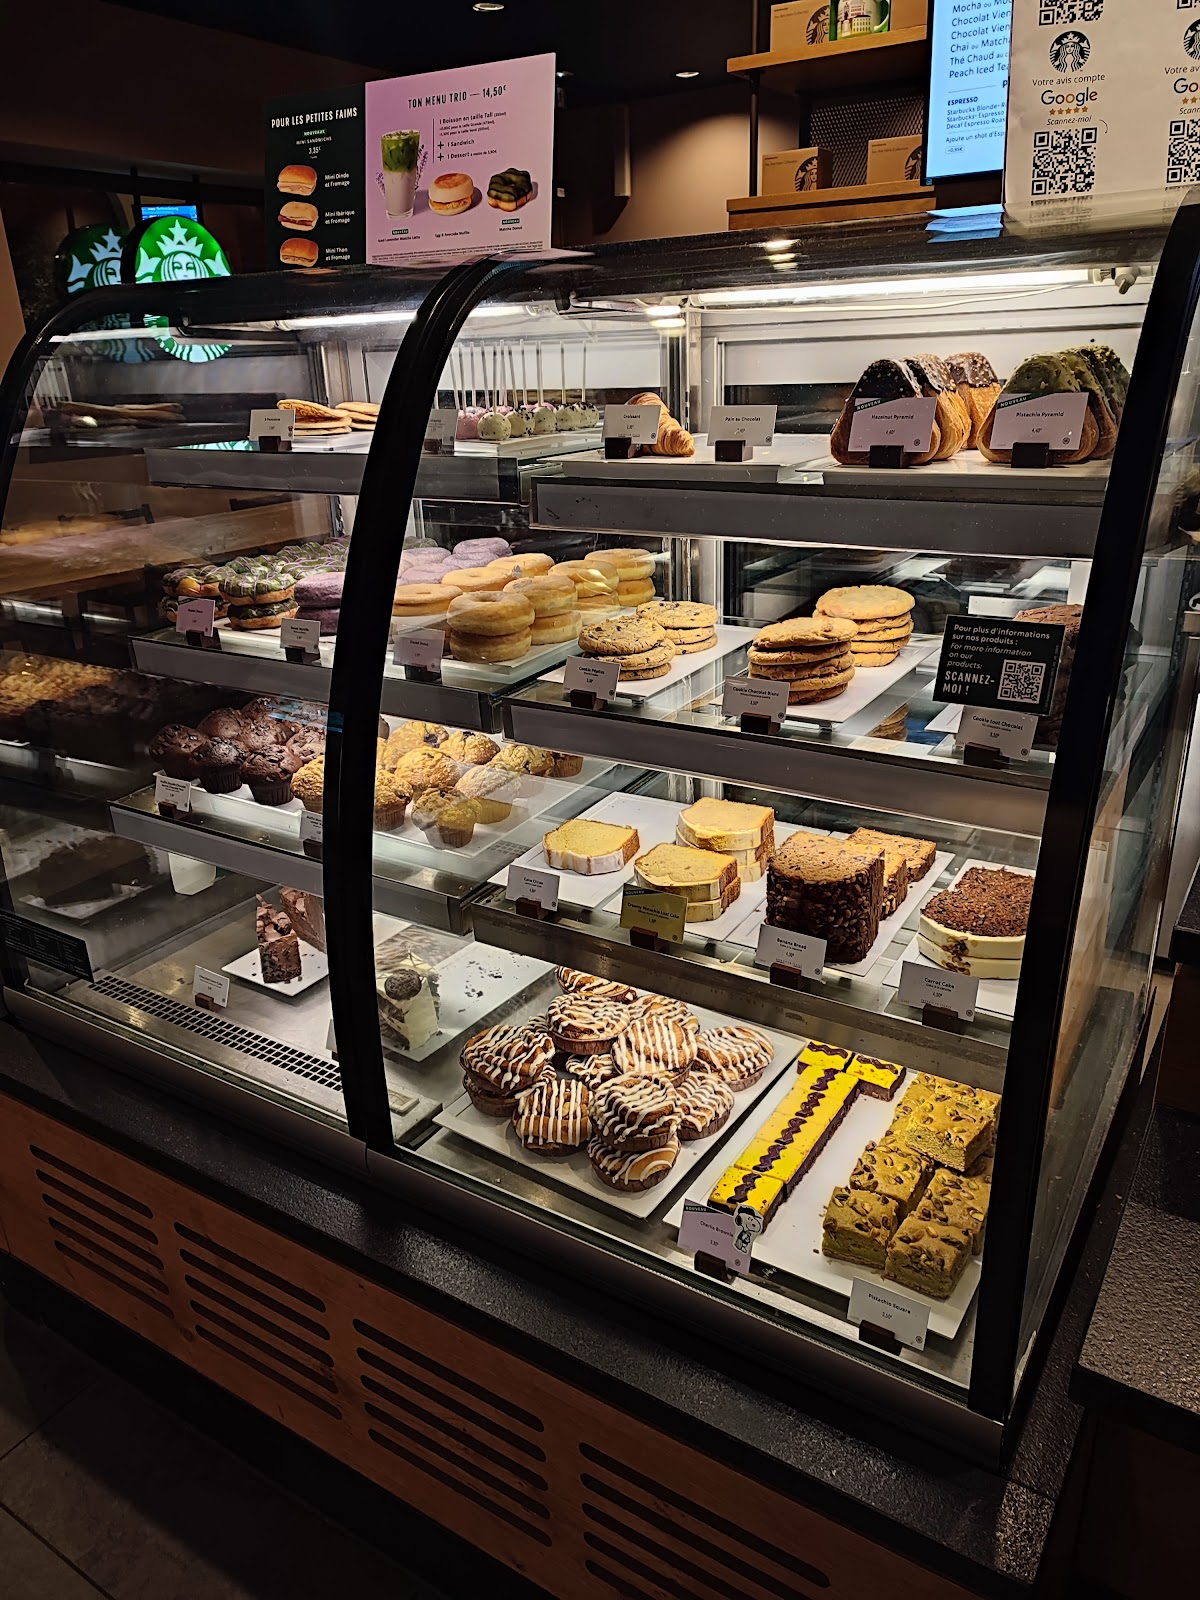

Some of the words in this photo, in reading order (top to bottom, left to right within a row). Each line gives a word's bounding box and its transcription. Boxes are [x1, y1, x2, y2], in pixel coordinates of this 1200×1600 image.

[952, 2, 982, 14] Mocha
[952, 13, 989, 27] Chocolat
[951, 26, 988, 40] Chocolat
[950, 42, 969, 53] Chai
[950, 56, 965, 66] Thé
[967, 51, 994, 63] Chaud
[949, 67, 974, 78] Peach
[976, 64, 995, 75] Iced
[1164, 66, 1188, 75] Votre
[1032, 79, 1054, 87] Votre
[1056, 76, 1072, 85] avis
[1074, 74, 1106, 84] compte
[1173, 78, 1199, 94] Go
[408, 98, 422, 109] TON
[425, 94, 447, 107] MENU
[449, 91, 467, 103] TRIO
[948, 96, 978, 106] ESPRESSO
[1041, 87, 1098, 106] Google
[947, 107, 976, 116] Starbucks
[978, 110, 1005, 119] Espresso
[271, 117, 290, 129] POUR
[292, 114, 304, 126] LES
[305, 110, 333, 124] PETITES
[335, 107, 358, 120] FAIMS
[1046, 115, 1092, 126] Scannez-moi
[946, 122, 963, 130] Decaf
[964, 119, 990, 128] Espresso
[450, 139, 475, 147] Sandwich
[946, 136, 964, 144] Ajoute
[856, 399, 881, 410] NOUVEAU
[1000, 396, 1027, 408] NOUVEAU
[953, 623, 972, 632] Pour
[972, 626, 989, 634] plus
[990, 627, 1050, 640] d'informations
[980, 636, 1014, 645] produits
[950, 642, 962, 650] For
[984, 646, 1032, 657] information
[946, 660, 982, 670] products:
[945, 670, 995, 685] SCANNEZ-
[942, 683, 962, 694] MOI
[972, 715, 989, 724] Cookie
[1001, 721, 1023, 731] Chocolat
[777, 938, 793, 946] Banana
[794, 942, 807, 950] Bread
[924, 977, 941, 986] Carrot
[942, 981, 955, 989] Cake
[700, 1220, 715, 1230] Charlie
[716, 1226, 734, 1237] Brownie
[868, 1293, 892, 1307] Pistachio
[892, 1303, 911, 1314] Square
